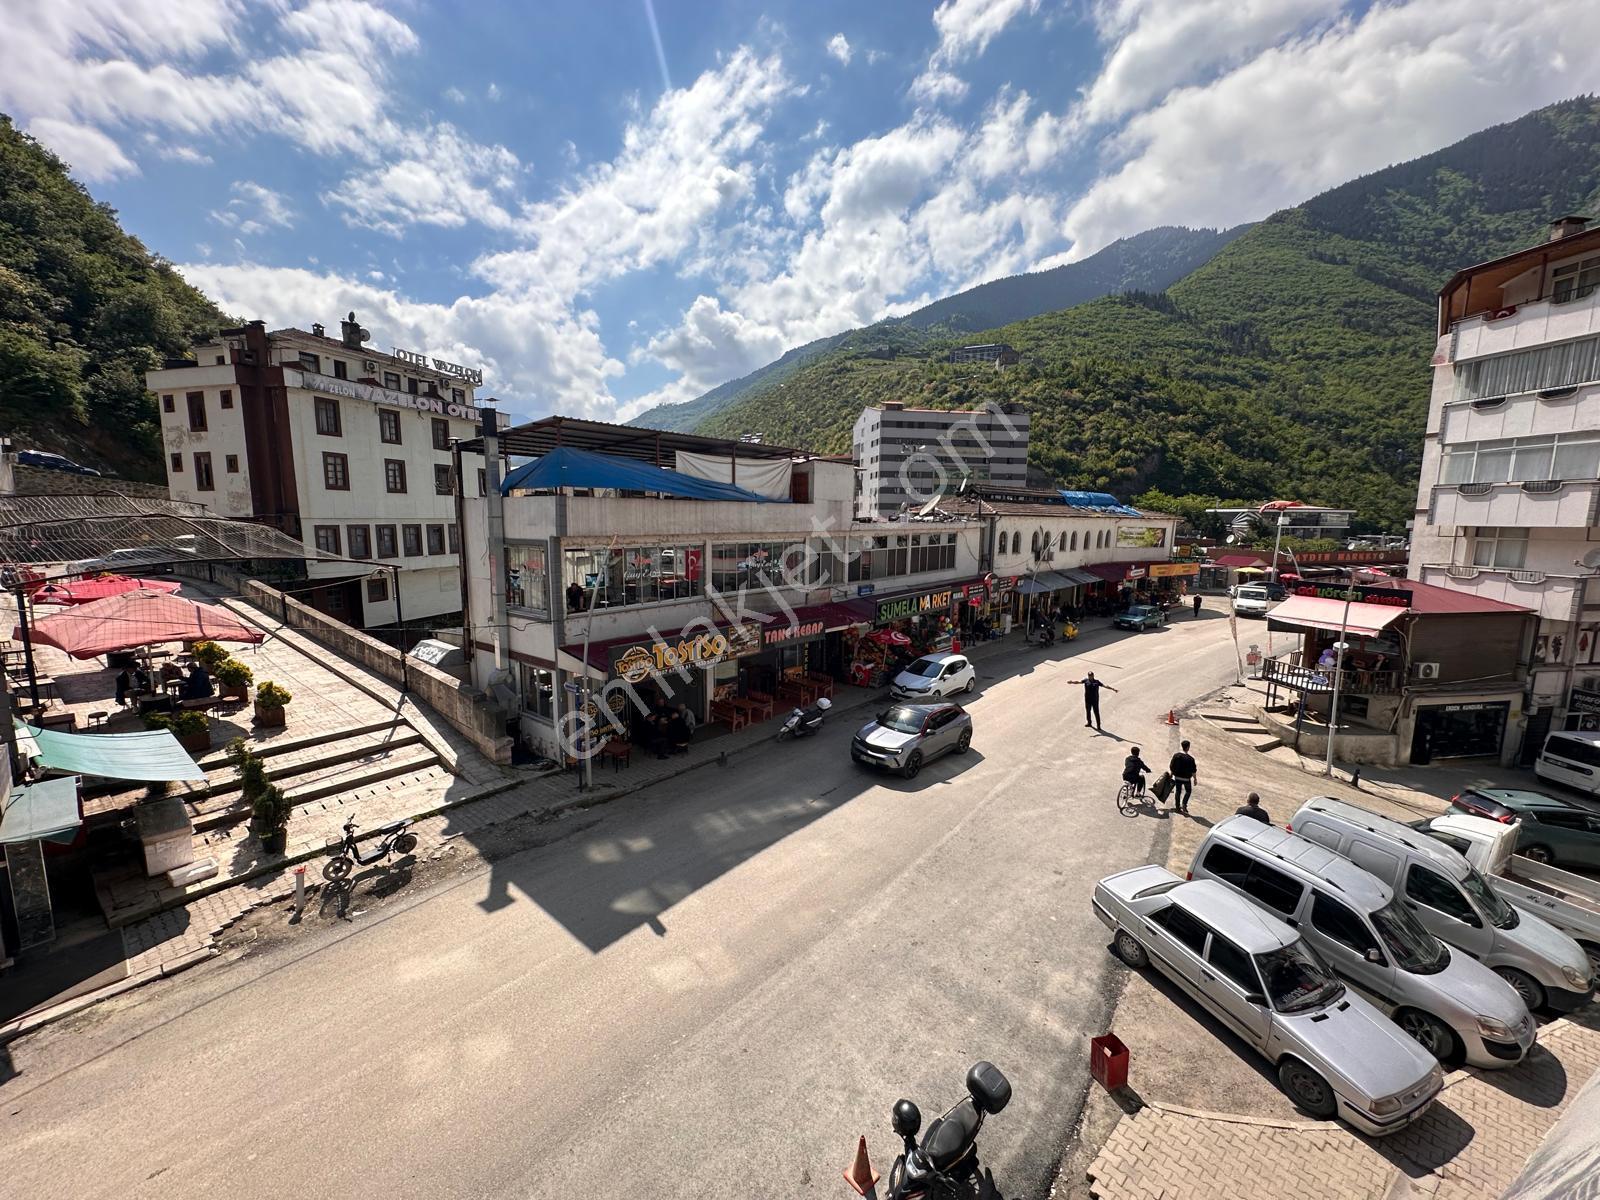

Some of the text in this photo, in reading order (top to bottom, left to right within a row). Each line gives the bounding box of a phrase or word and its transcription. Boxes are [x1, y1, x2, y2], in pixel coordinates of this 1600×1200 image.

[447, 404, 482, 421] OTEL
[919, 591, 952, 612] MARKET
[793, 621, 824, 638] KEBAP
